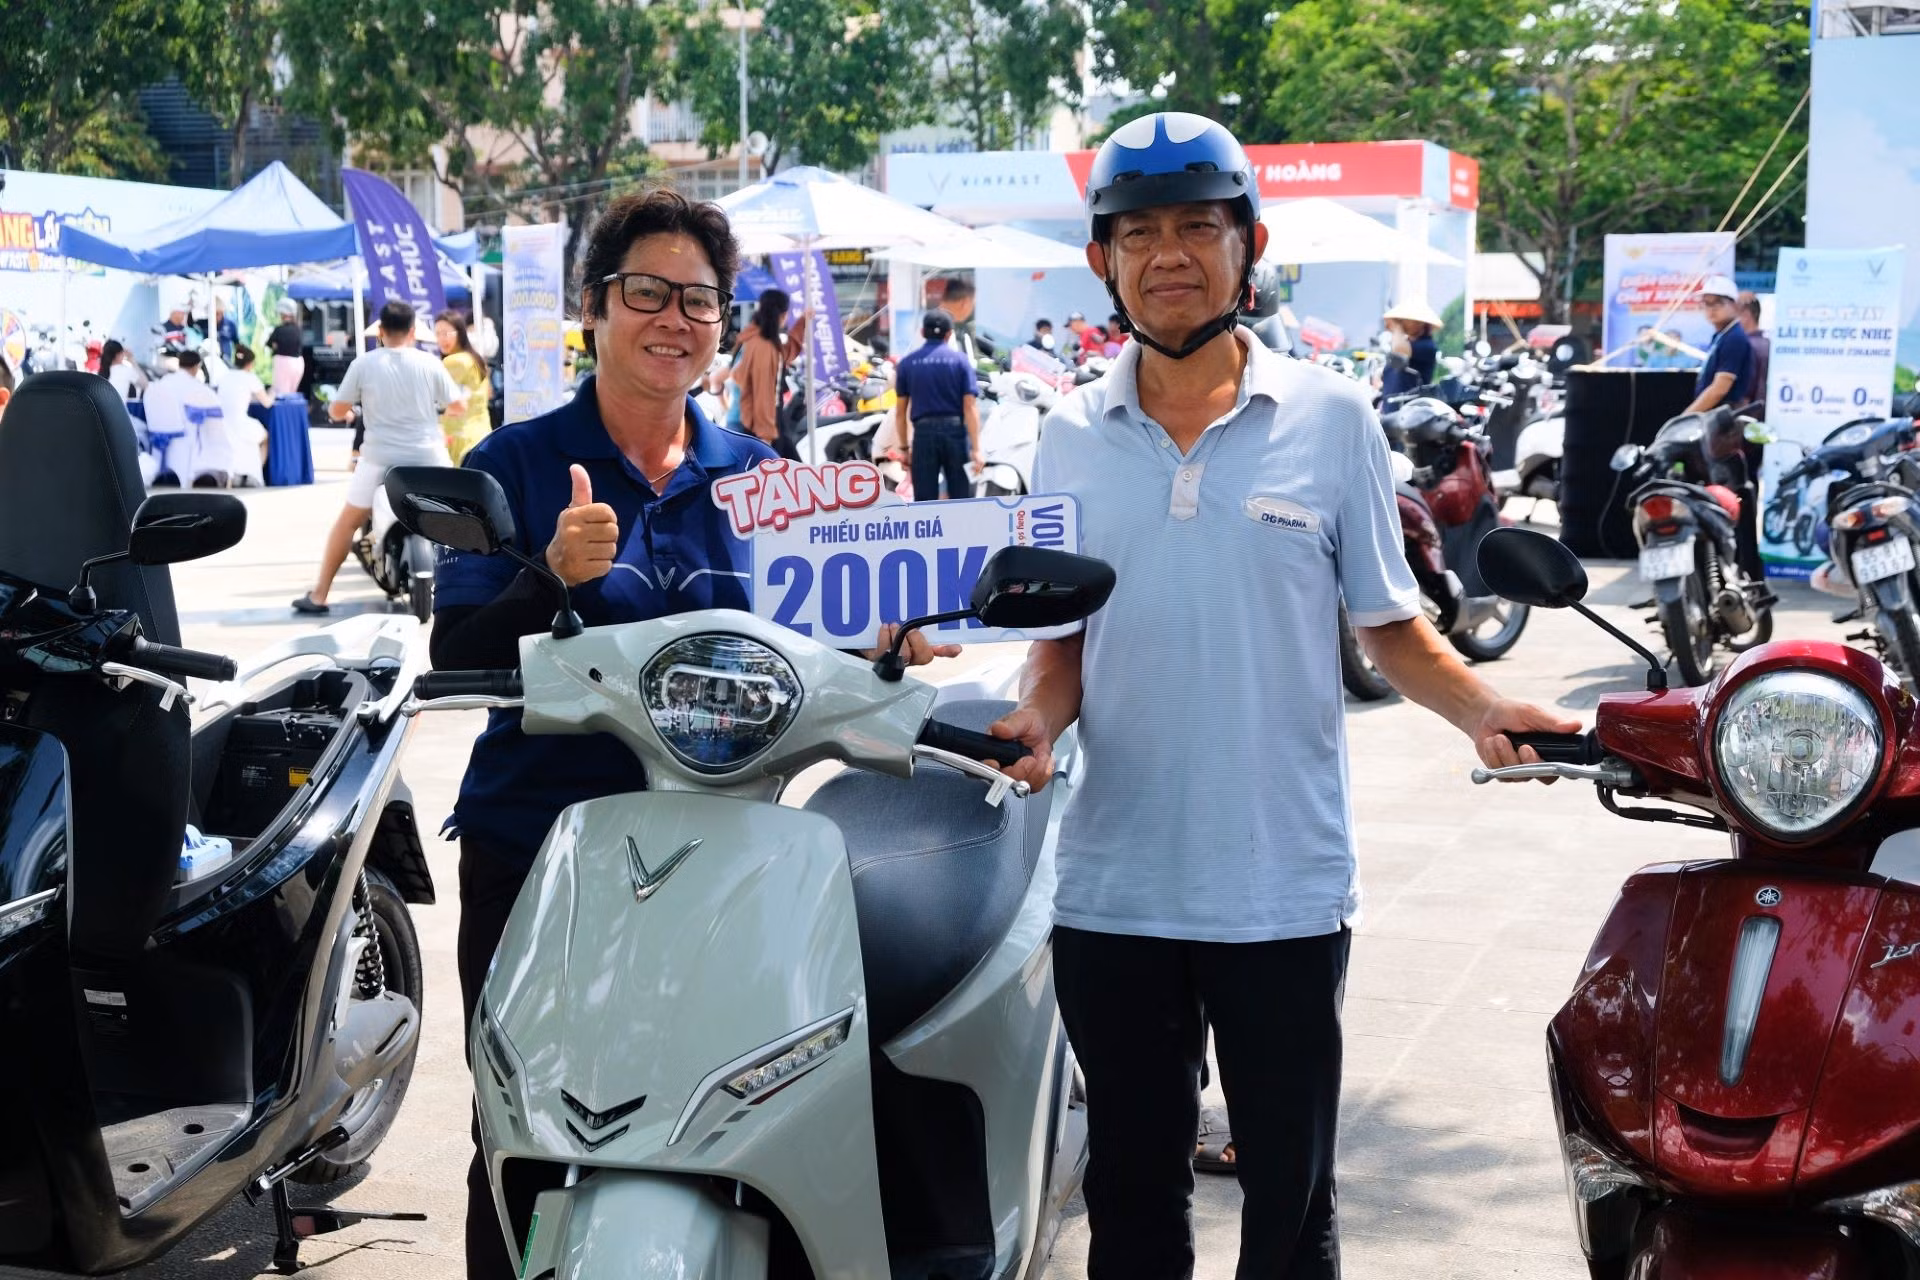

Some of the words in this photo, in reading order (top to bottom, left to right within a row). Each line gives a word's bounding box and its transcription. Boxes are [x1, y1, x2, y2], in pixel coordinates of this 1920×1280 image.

[1265, 159, 1342, 182] HOÀNG
[366, 219, 401, 301] FAST
[392, 222, 429, 297] PHÚC
[814, 313, 840, 374] THIÊN
[1780, 385, 1793, 403] 0
[1811, 386, 1823, 404] 0
[1853, 387, 1867, 406] 0
[716, 459, 881, 532] TẶNG
[809, 518, 860, 544] PHIẾU
[865, 516, 909, 542] GIẢM
[915, 515, 943, 540] GIÁ
[1016, 510, 1026, 530] Quay
[1277, 518, 1307, 529] PHARMA
[767, 546, 989, 637] 200K
